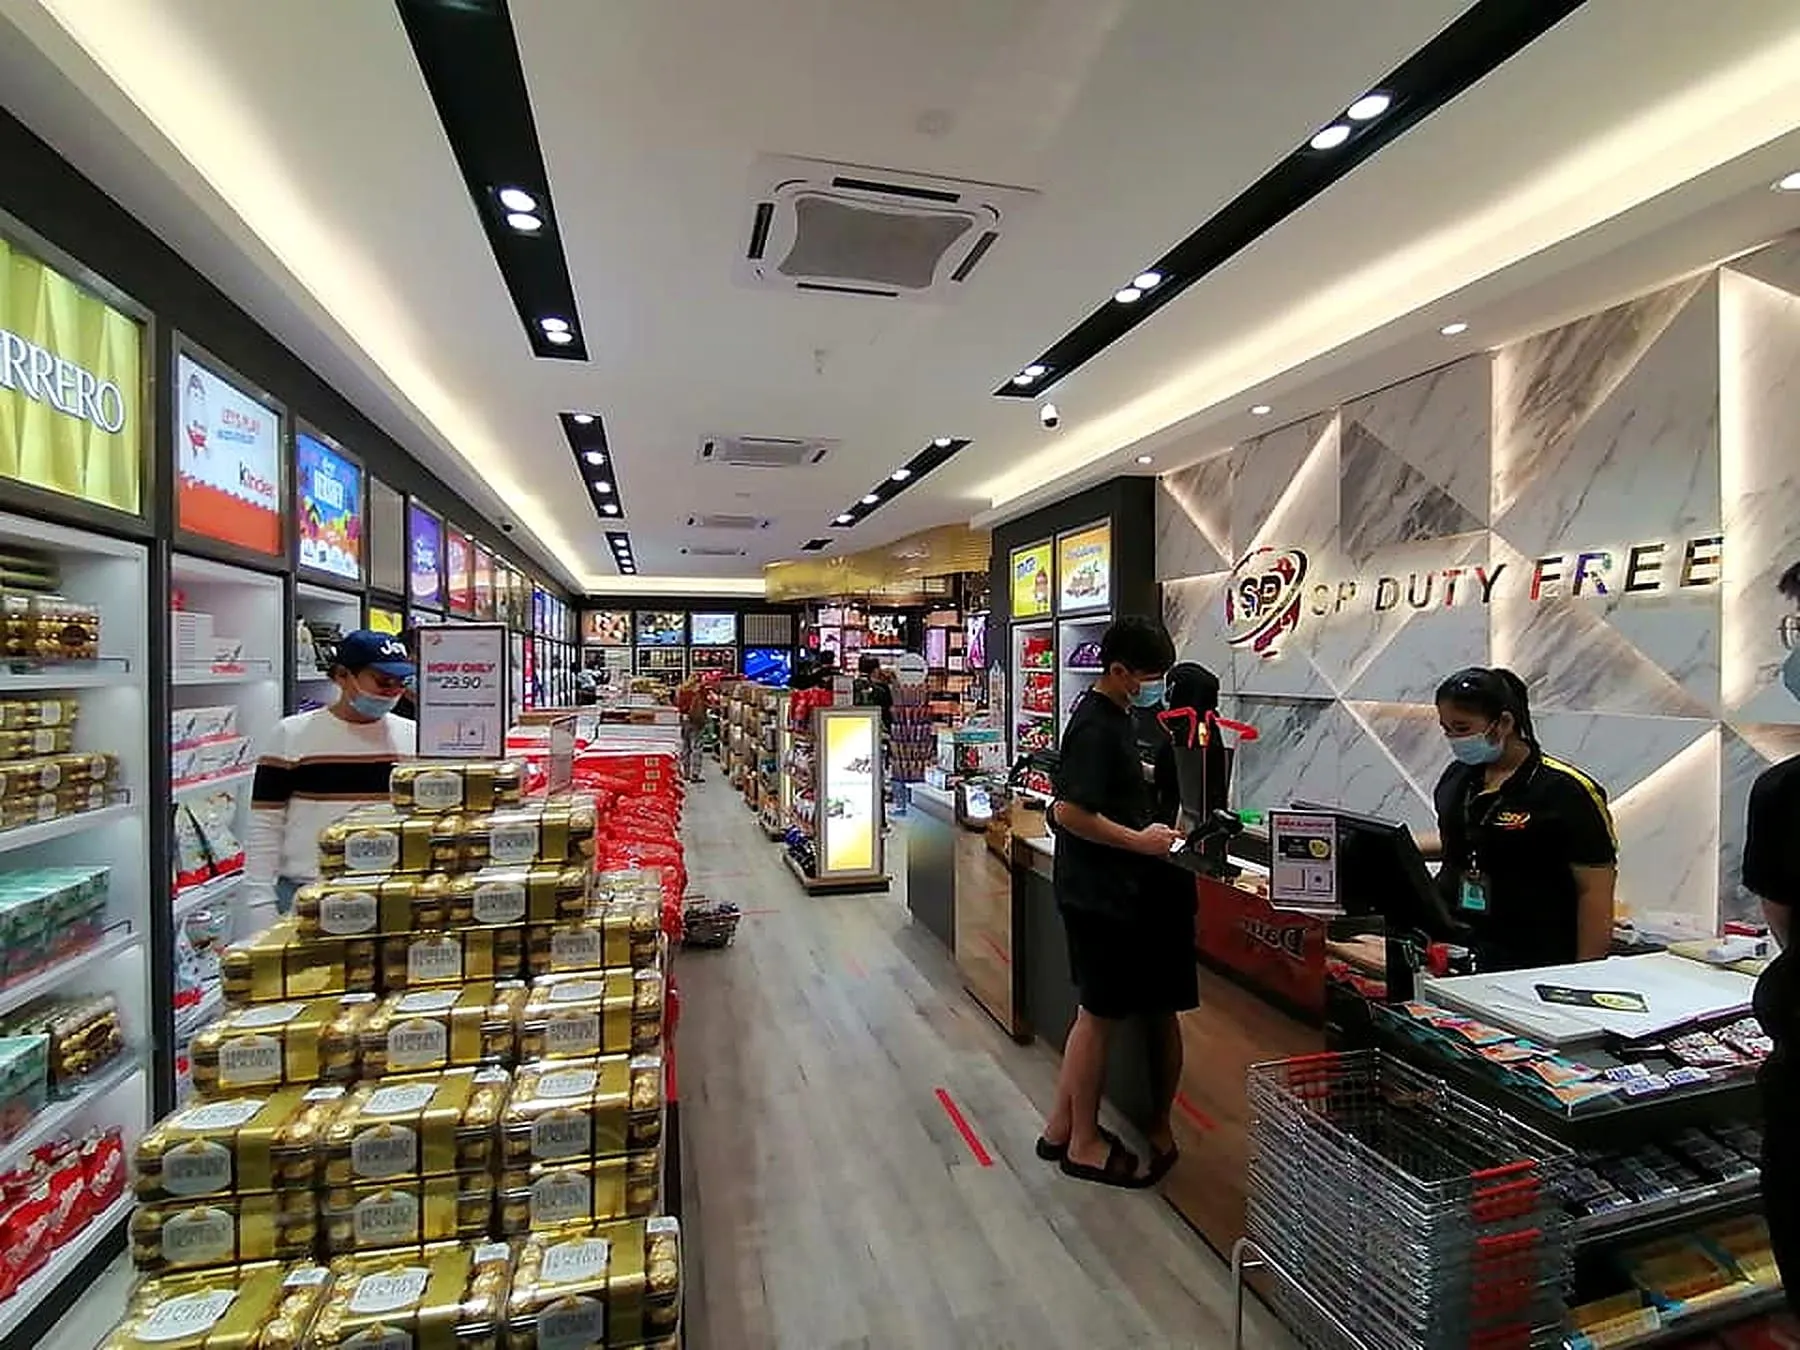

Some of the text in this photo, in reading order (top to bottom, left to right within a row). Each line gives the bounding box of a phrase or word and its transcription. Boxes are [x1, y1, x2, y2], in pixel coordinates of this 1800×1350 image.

[0, 328, 125, 434] RRERO
[1311, 535, 1724, 615] SP DUTY FREE
